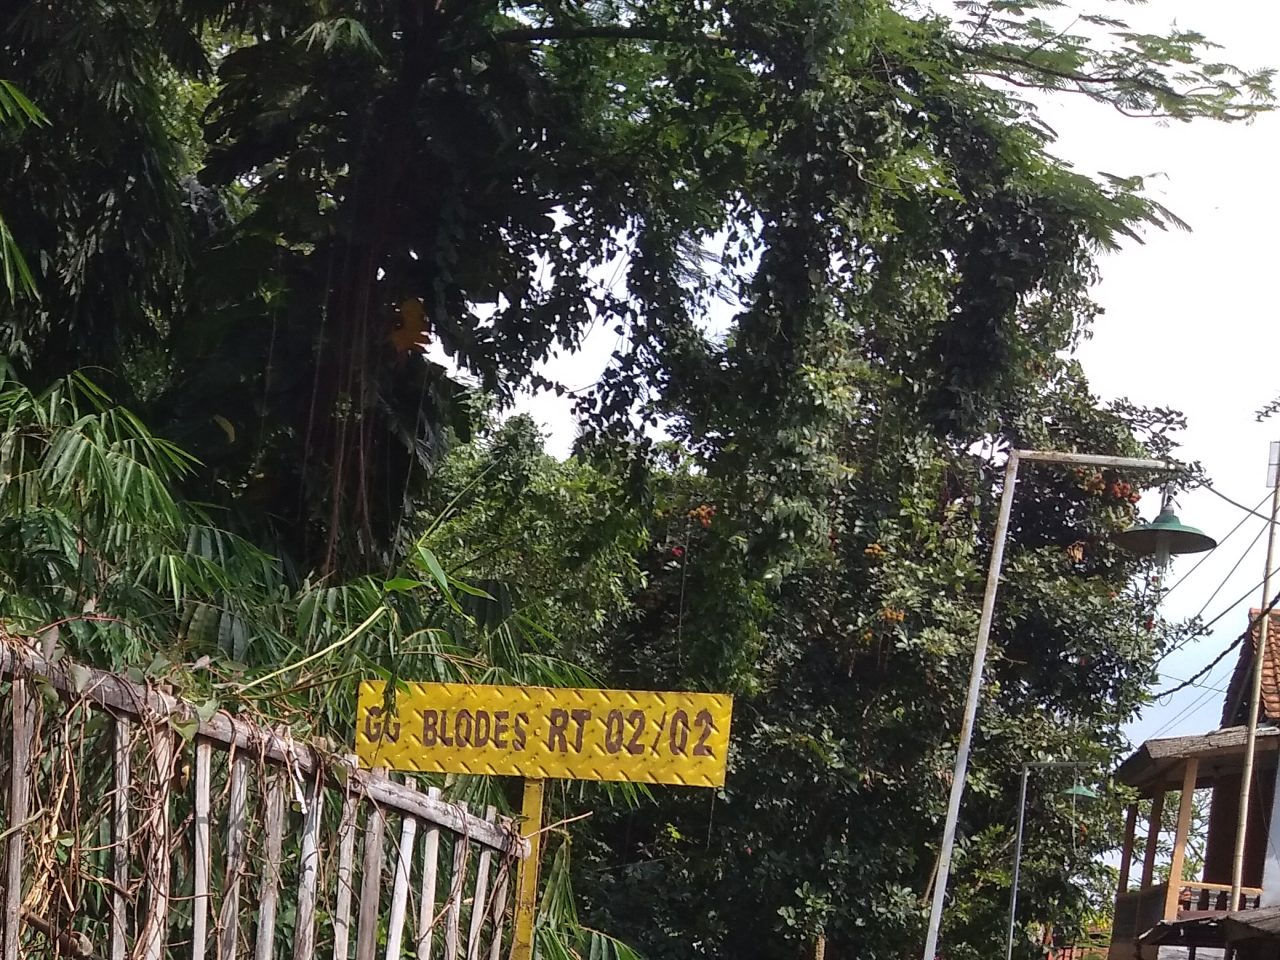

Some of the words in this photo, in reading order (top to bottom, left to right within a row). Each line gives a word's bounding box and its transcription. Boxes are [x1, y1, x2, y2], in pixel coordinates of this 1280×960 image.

[423, 708, 529, 752] BLODES
[548, 708, 591, 753] RT
[604, 708, 713, 756] 02/02
